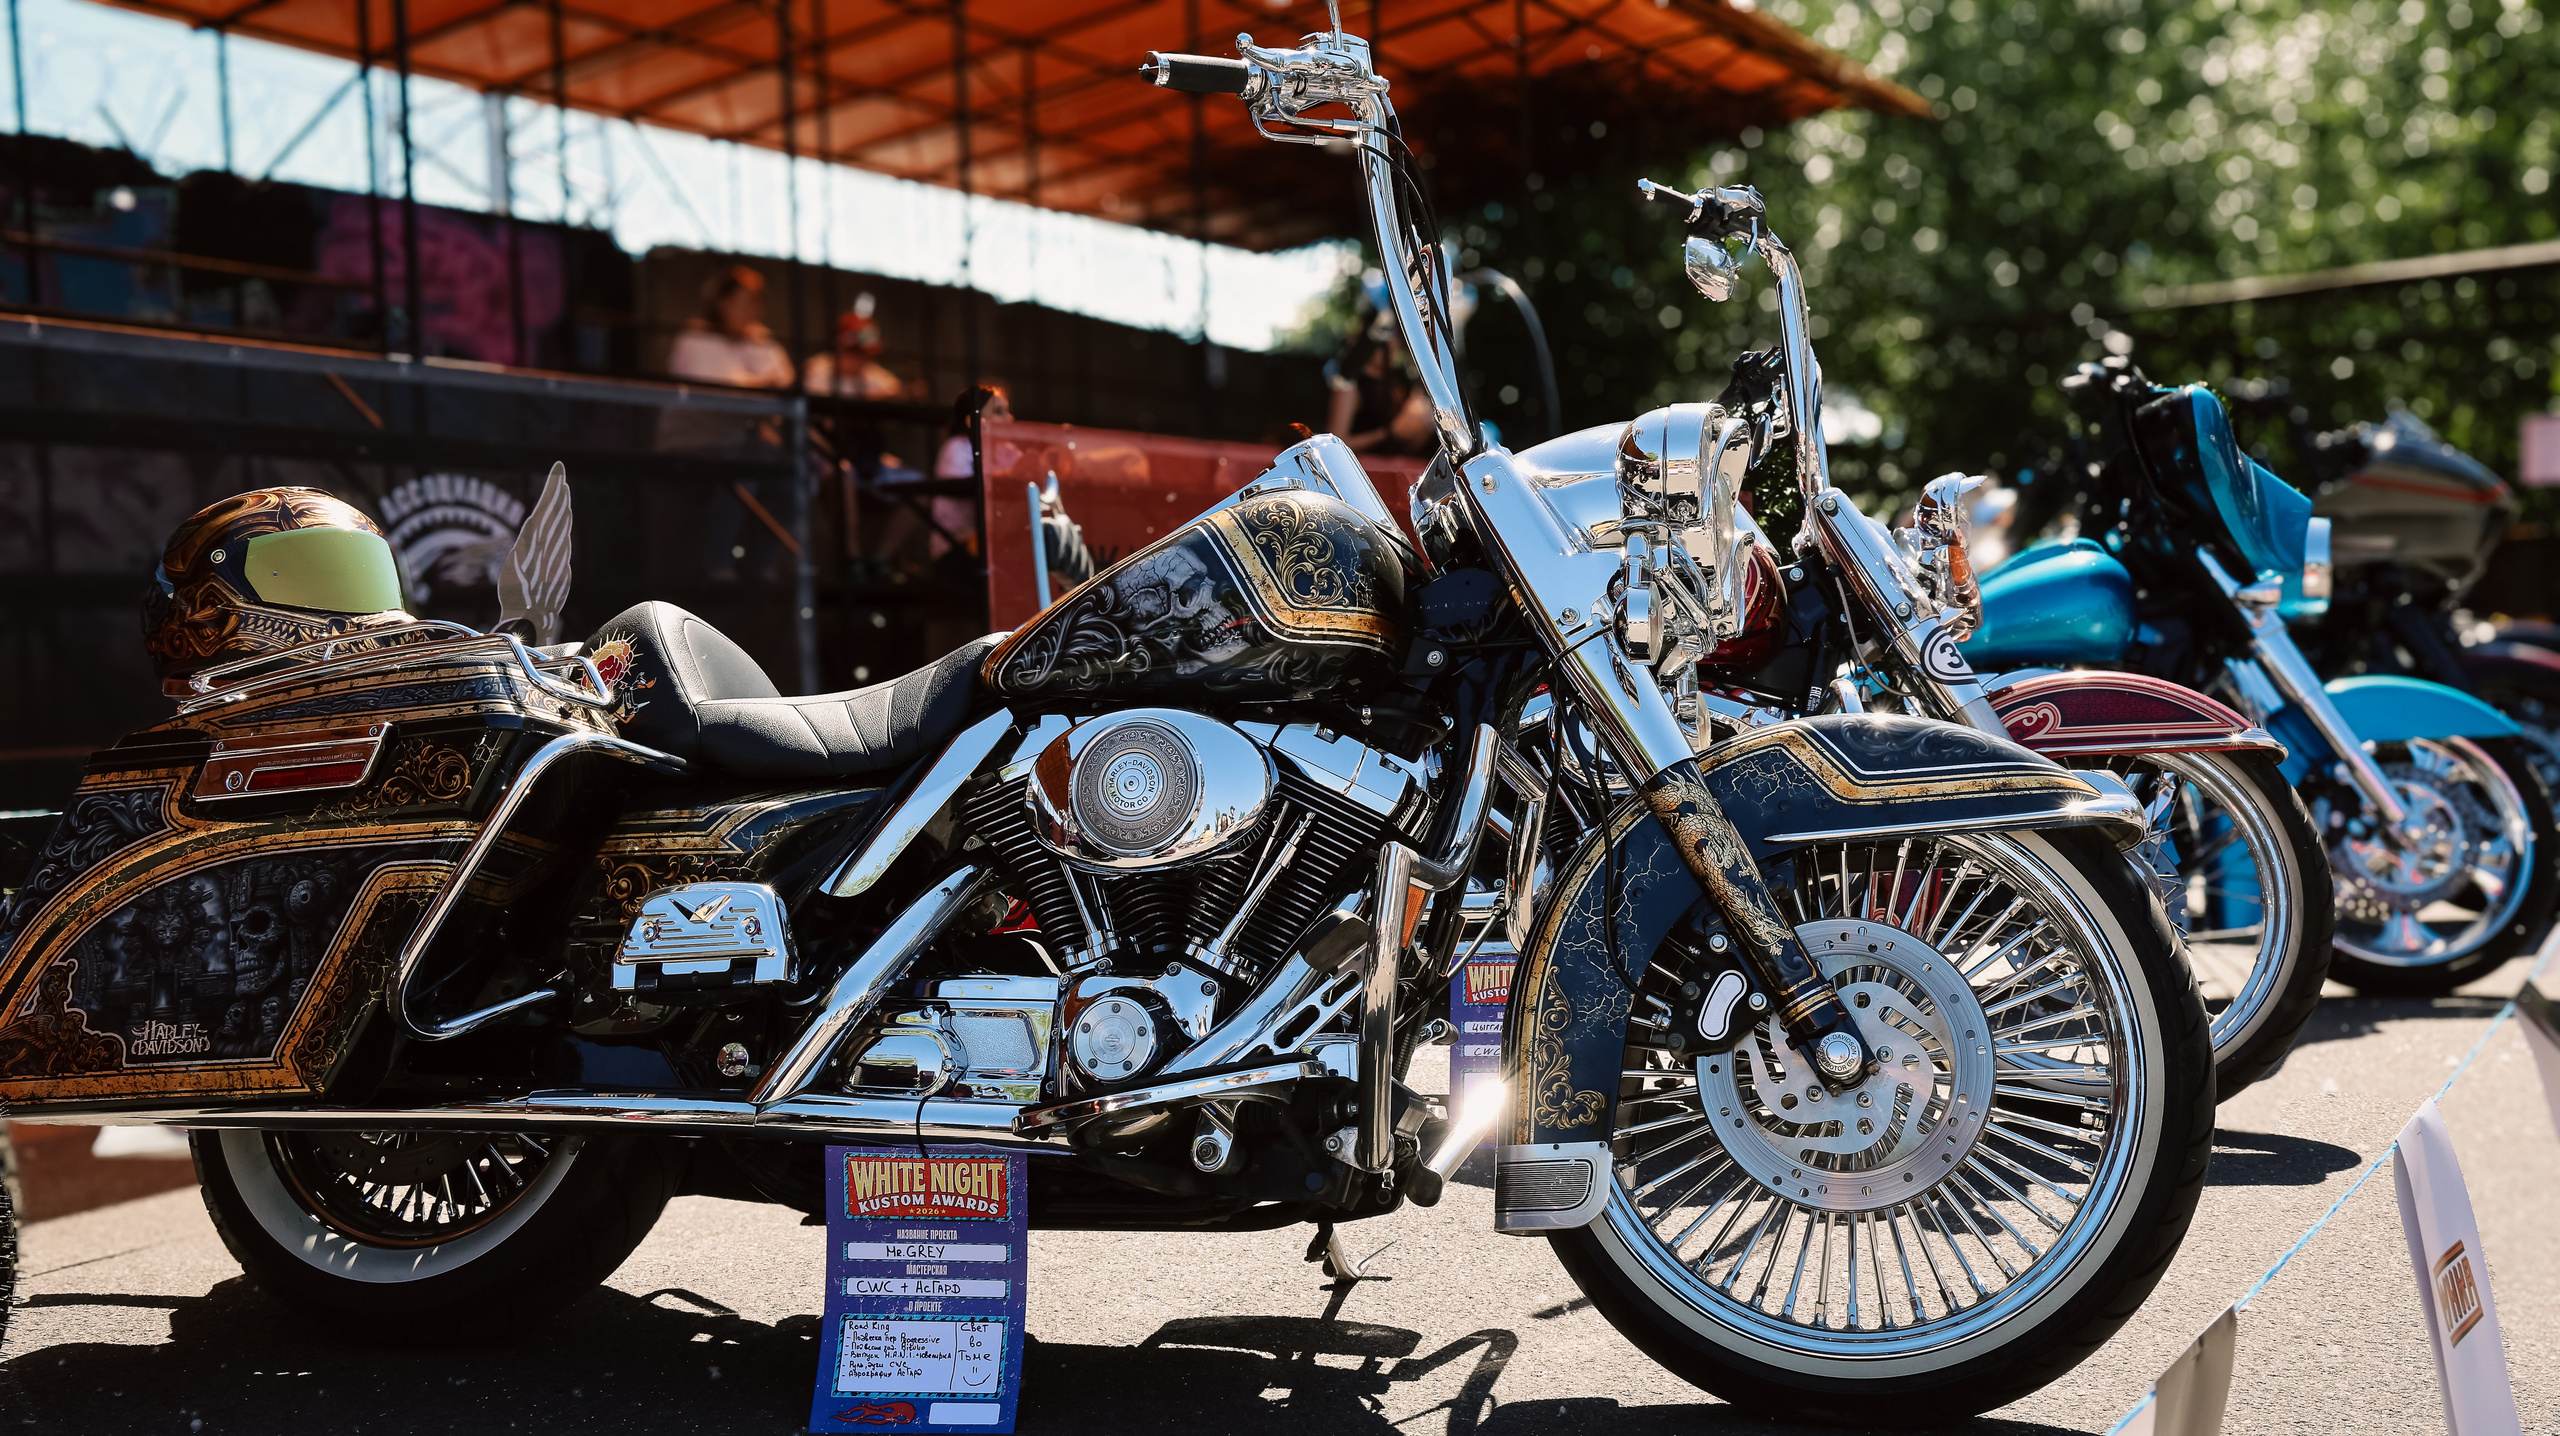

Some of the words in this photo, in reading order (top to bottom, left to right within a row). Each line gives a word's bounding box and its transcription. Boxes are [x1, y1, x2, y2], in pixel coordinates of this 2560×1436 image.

[1940, 642, 1964, 669] 3
[1108, 759, 1156, 793] HARLEY-DAVIDSON
[1110, 791, 1136, 808] MOTOR
[1472, 988, 1508, 1002] KUSTO
[850, 1160, 926, 1200] WHITE
[930, 1162, 1003, 1201] NIGHT
[858, 1194, 925, 1214] KUSTOM
[931, 1194, 999, 1215] AWARDS
[916, 1207, 939, 1215] 2026
[896, 1229, 929, 1240] НАЗВАНИЕ
[930, 1230, 958, 1240] ПРОЕКТА
[906, 1264, 948, 1276] МАСТЕРСКАЯ
[856, 1280, 894, 1293] CWC
[914, 1301, 942, 1312] ПРОЕКТЕ
[849, 1321, 869, 1330] Road
[872, 1321, 890, 1331] King
